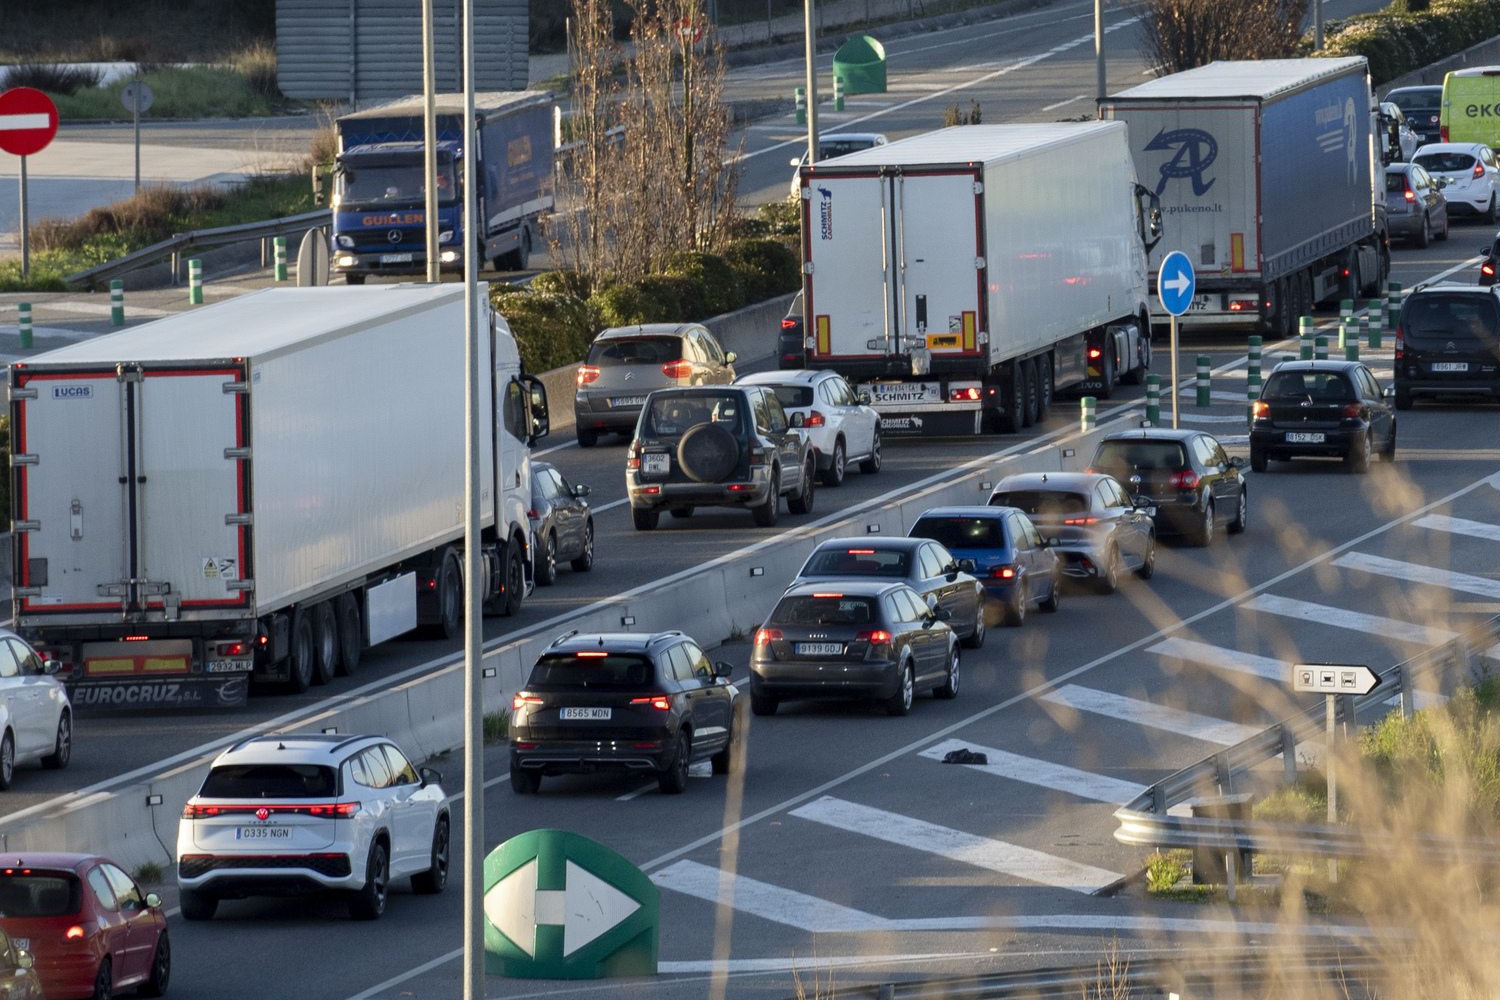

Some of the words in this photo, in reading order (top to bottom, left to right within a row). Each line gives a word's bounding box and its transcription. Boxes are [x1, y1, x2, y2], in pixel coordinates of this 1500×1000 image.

[362, 213, 424, 226] GUILLEN
[54, 386, 90, 398] LUCAS
[875, 392, 924, 402] SCHMITZ
[801, 645, 823, 653] 9139
[824, 645, 841, 653] GDJ
[211, 662, 233, 672] 2932
[235, 661, 252, 671] MLP
[566, 709, 589, 718] 8565
[591, 709, 610, 718] MDN
[244, 829, 268, 838] 0335
[270, 829, 289, 838] NGN
